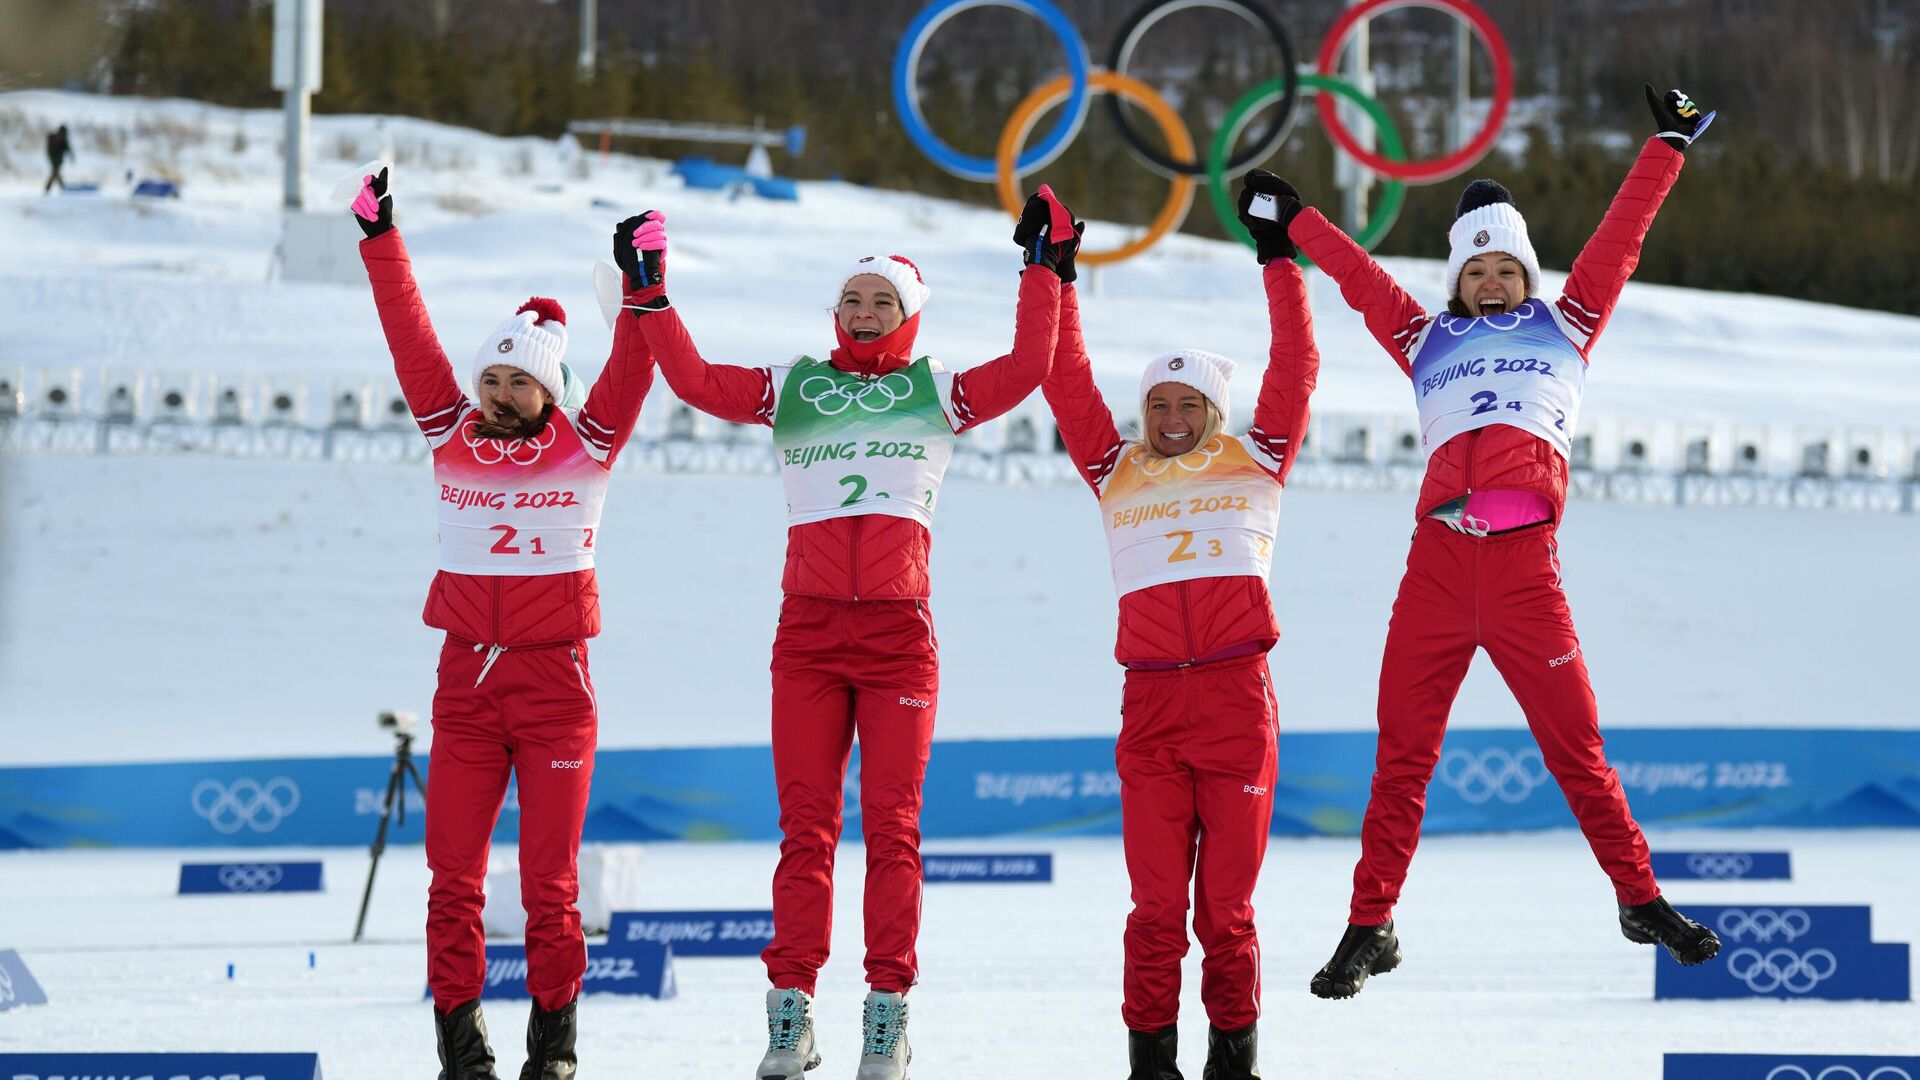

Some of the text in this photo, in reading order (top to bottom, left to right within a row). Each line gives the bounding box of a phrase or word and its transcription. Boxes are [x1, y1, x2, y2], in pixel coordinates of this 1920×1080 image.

[1422, 358, 1558, 398] BEIJING 2022
[1470, 390, 1523, 416] 2 4
[1554, 409, 1566, 431] 2
[784, 441, 929, 469] BEIJING 2022
[441, 484, 581, 510] BEIJING 2022
[838, 474, 868, 507] 2
[924, 489, 933, 508] 2
[1113, 495, 1254, 529] BEIJING 2022
[488, 524, 546, 555] 2 1
[583, 528, 594, 547] 2
[1165, 530, 1223, 563] 2 3
[1548, 649, 1577, 668] BOSCO
[899, 696, 927, 709] BOSCO
[551, 760, 580, 769] BOSCO
[626, 920, 715, 946] BEIJING
